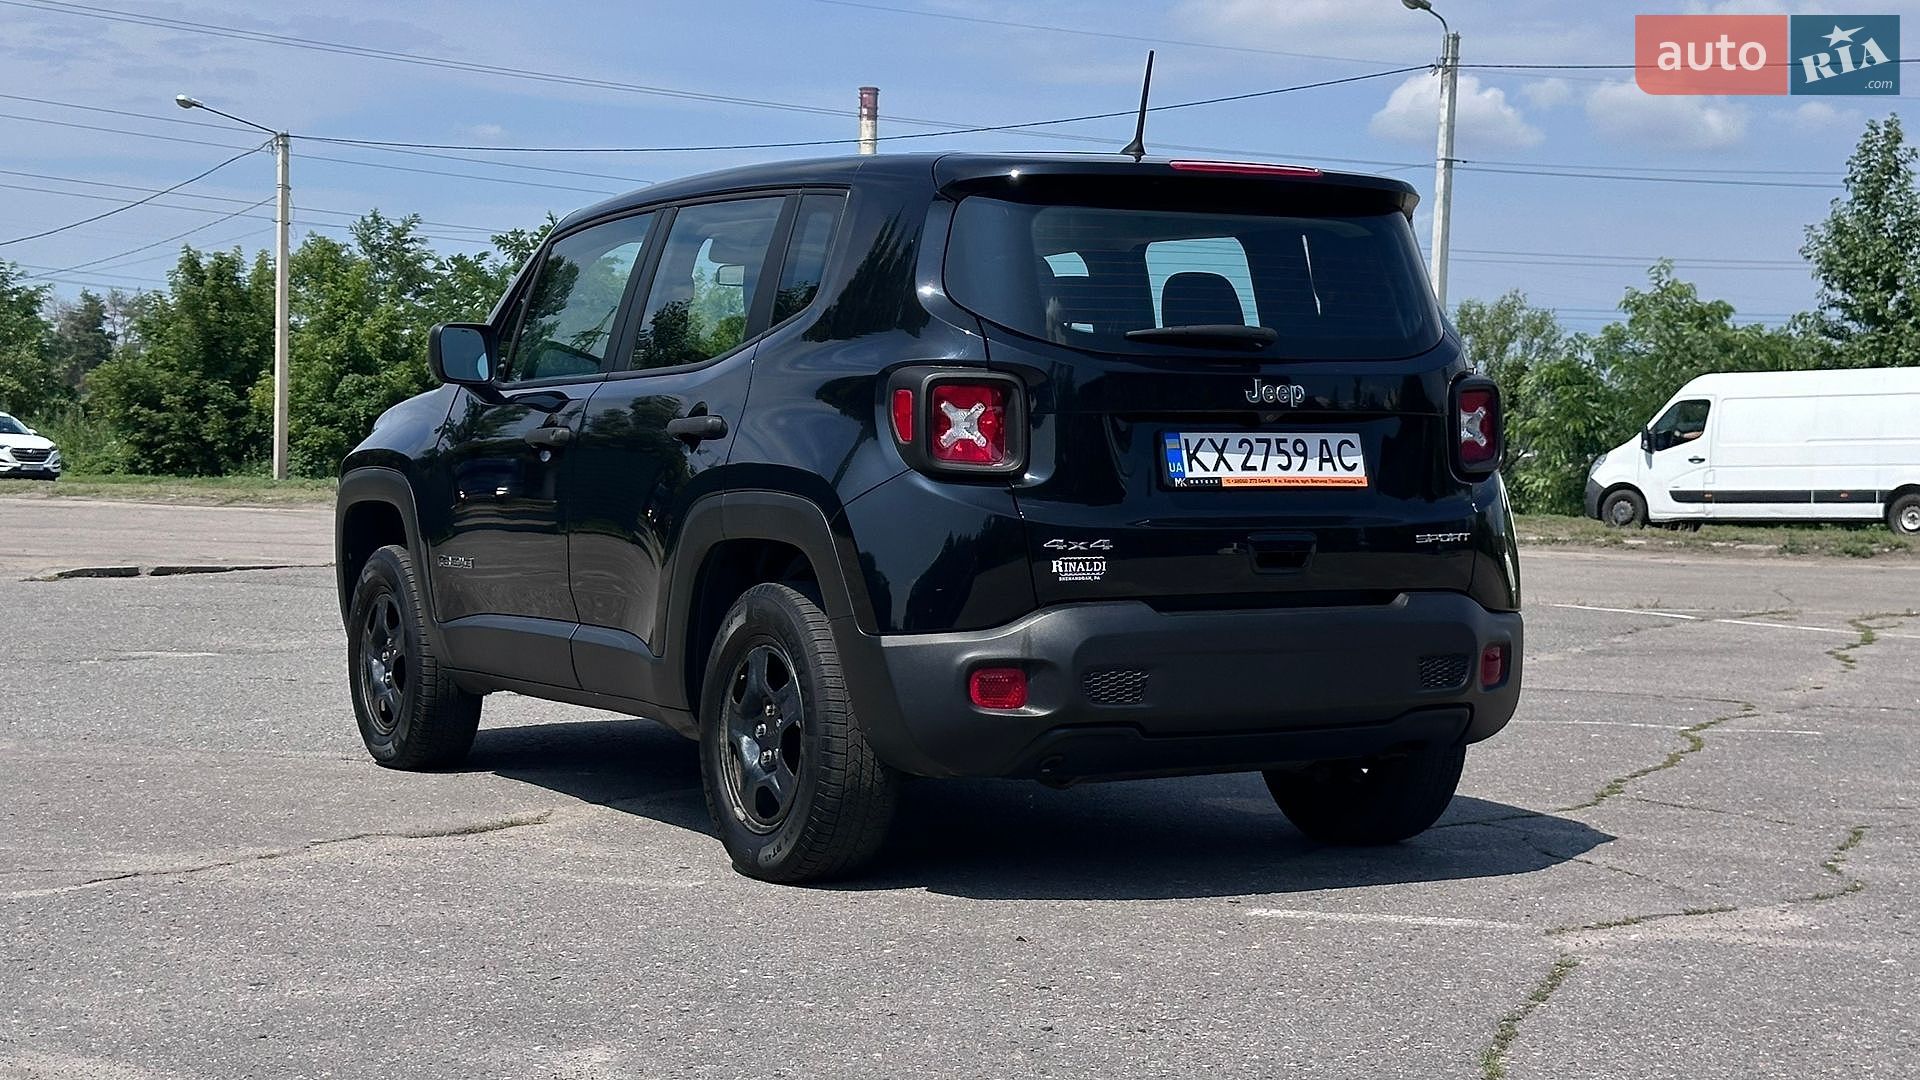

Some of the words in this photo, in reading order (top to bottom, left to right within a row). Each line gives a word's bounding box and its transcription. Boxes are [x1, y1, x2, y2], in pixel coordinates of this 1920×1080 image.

[1245, 378, 1306, 408] Jeep
[1184, 438, 1234, 473] KX
[1237, 438, 1307, 472] 2759
[1318, 438, 1359, 472] AC
[1168, 461, 1184, 473] UA
[1043, 538, 1114, 550] 4x4
[1415, 532, 1471, 544] SPORT
[1051, 559, 1107, 573] RINALDI
